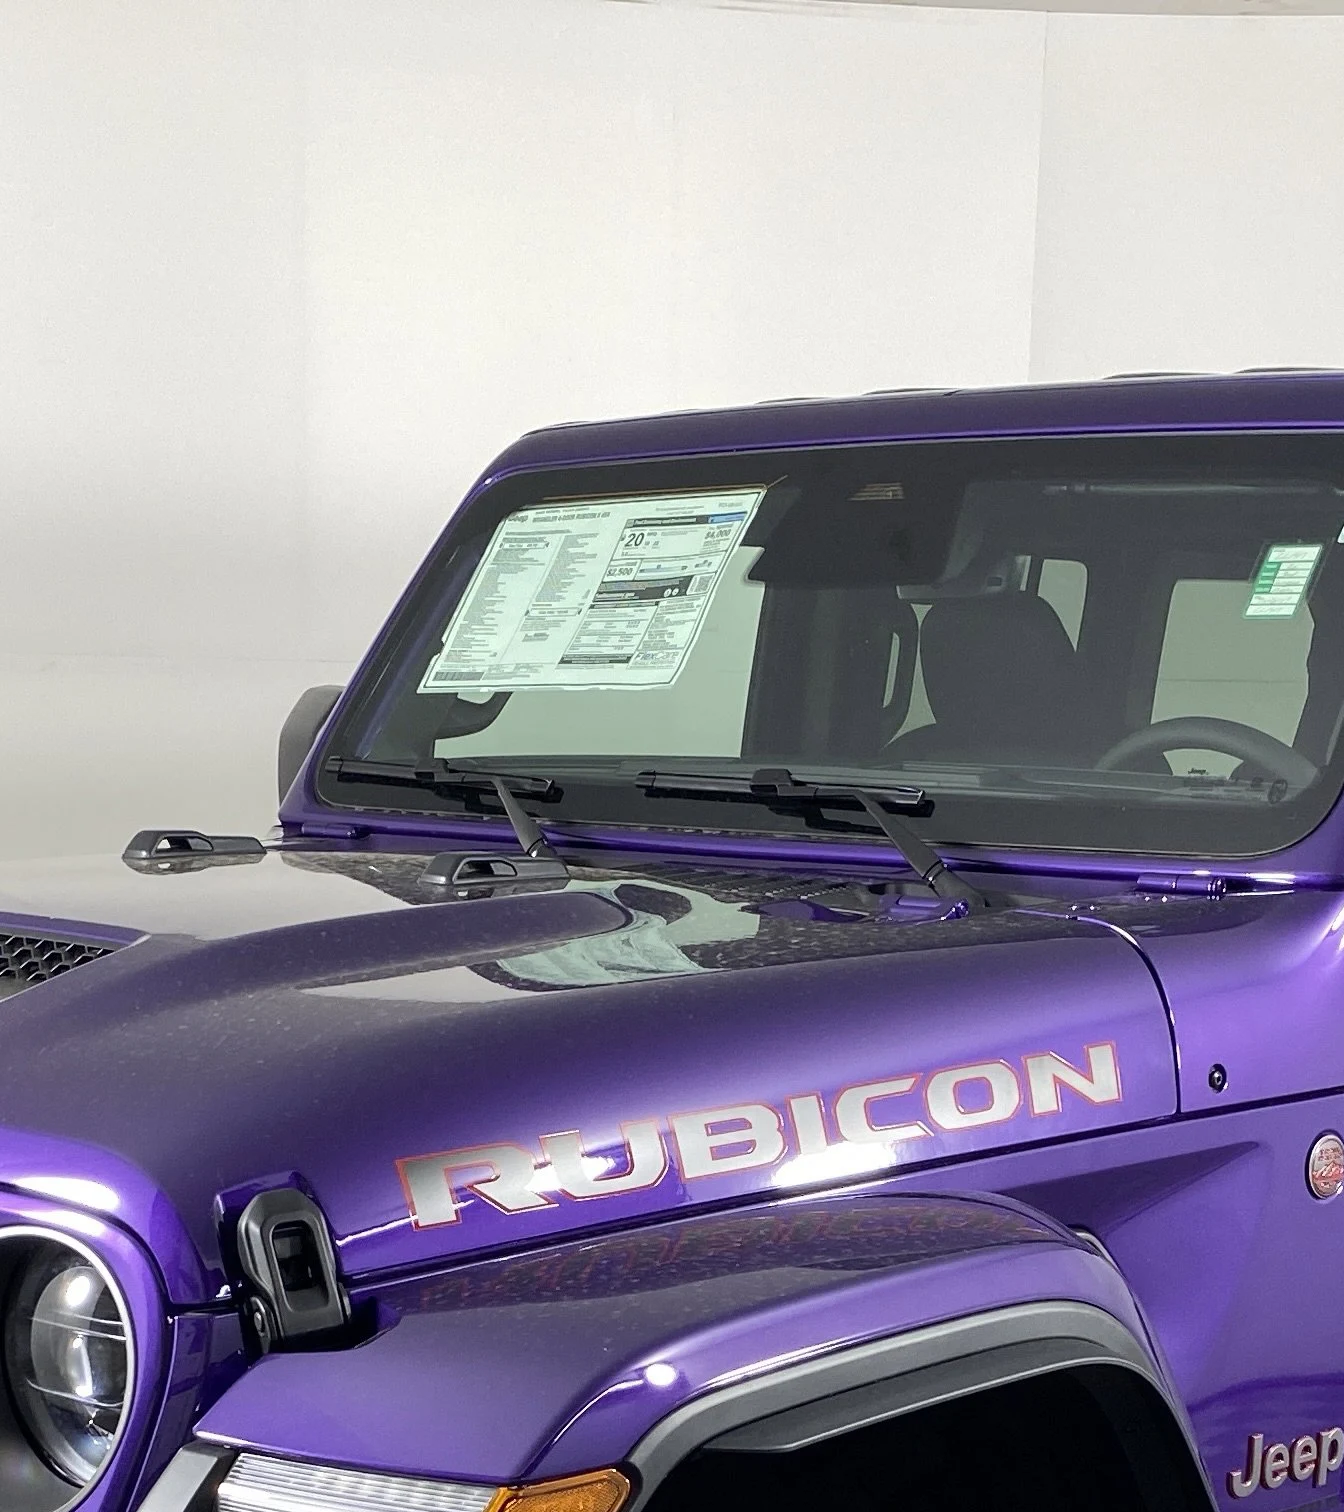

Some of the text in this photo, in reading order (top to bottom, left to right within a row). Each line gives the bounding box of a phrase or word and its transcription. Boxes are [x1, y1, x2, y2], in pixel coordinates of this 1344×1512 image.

[624, 532, 645, 547] 20
[606, 567, 633, 577] $2,500
[395, 1041, 1123, 1231] RUBICON
